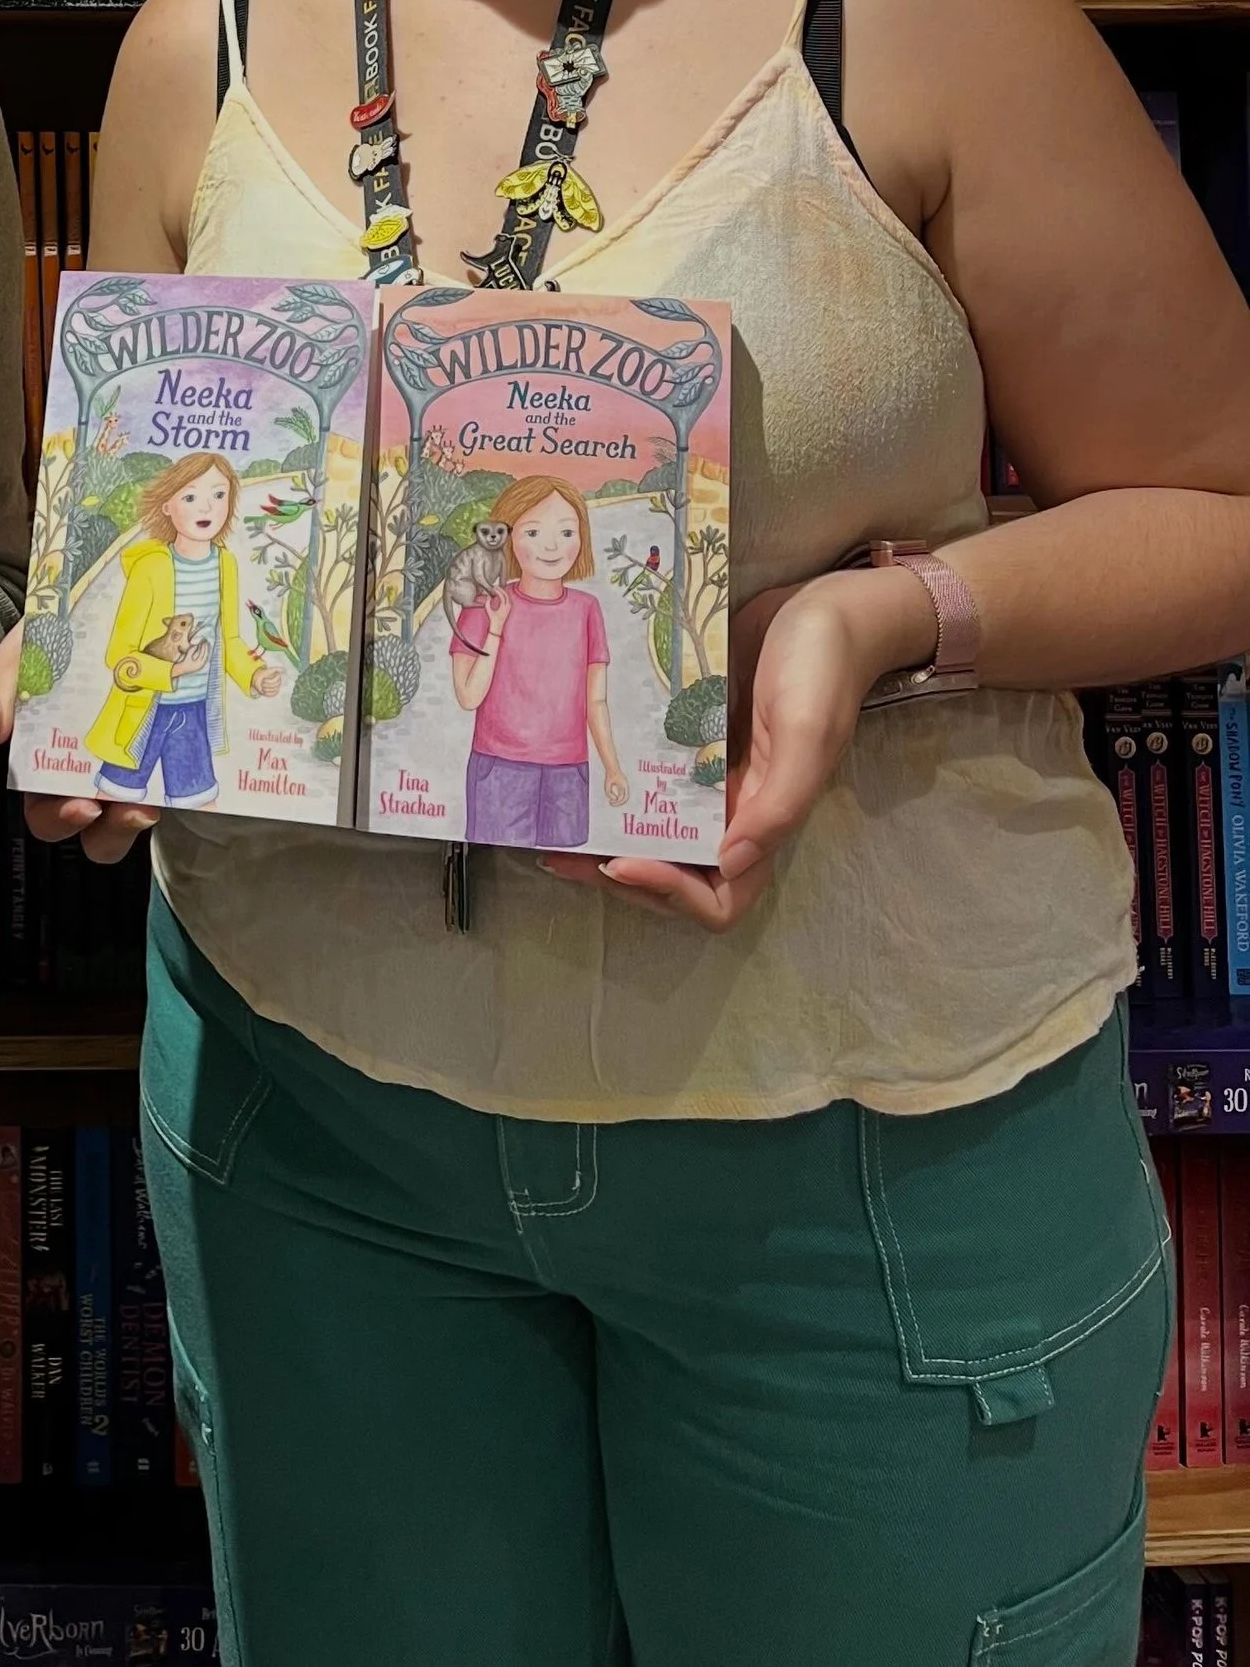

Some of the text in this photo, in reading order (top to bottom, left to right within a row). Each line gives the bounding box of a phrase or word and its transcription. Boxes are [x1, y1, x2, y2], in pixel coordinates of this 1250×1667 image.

[365, 14, 379, 82] BOOK
[105, 312, 318, 378] WILDER ZOO
[436, 325, 666, 394] WILDER ZOO
[155, 369, 254, 410] Neeka
[506, 382, 592, 412] Neeka
[149, 413, 251, 452] Storm
[186, 412, 242, 425] and the
[525, 412, 576, 425] and the
[459, 423, 638, 459] Great Search
[50, 728, 79, 750] Tina
[31, 750, 92, 775] Strachan
[258, 749, 289, 772] Max
[238, 772, 308, 798] Hamilton
[398, 770, 430, 794] Tina
[379, 792, 446, 819] Strachan
[644, 792, 678, 815] Max
[622, 813, 700, 842] Hamilton
[1231, 814, 1250, 953] OLIVIA WAKEFORD
